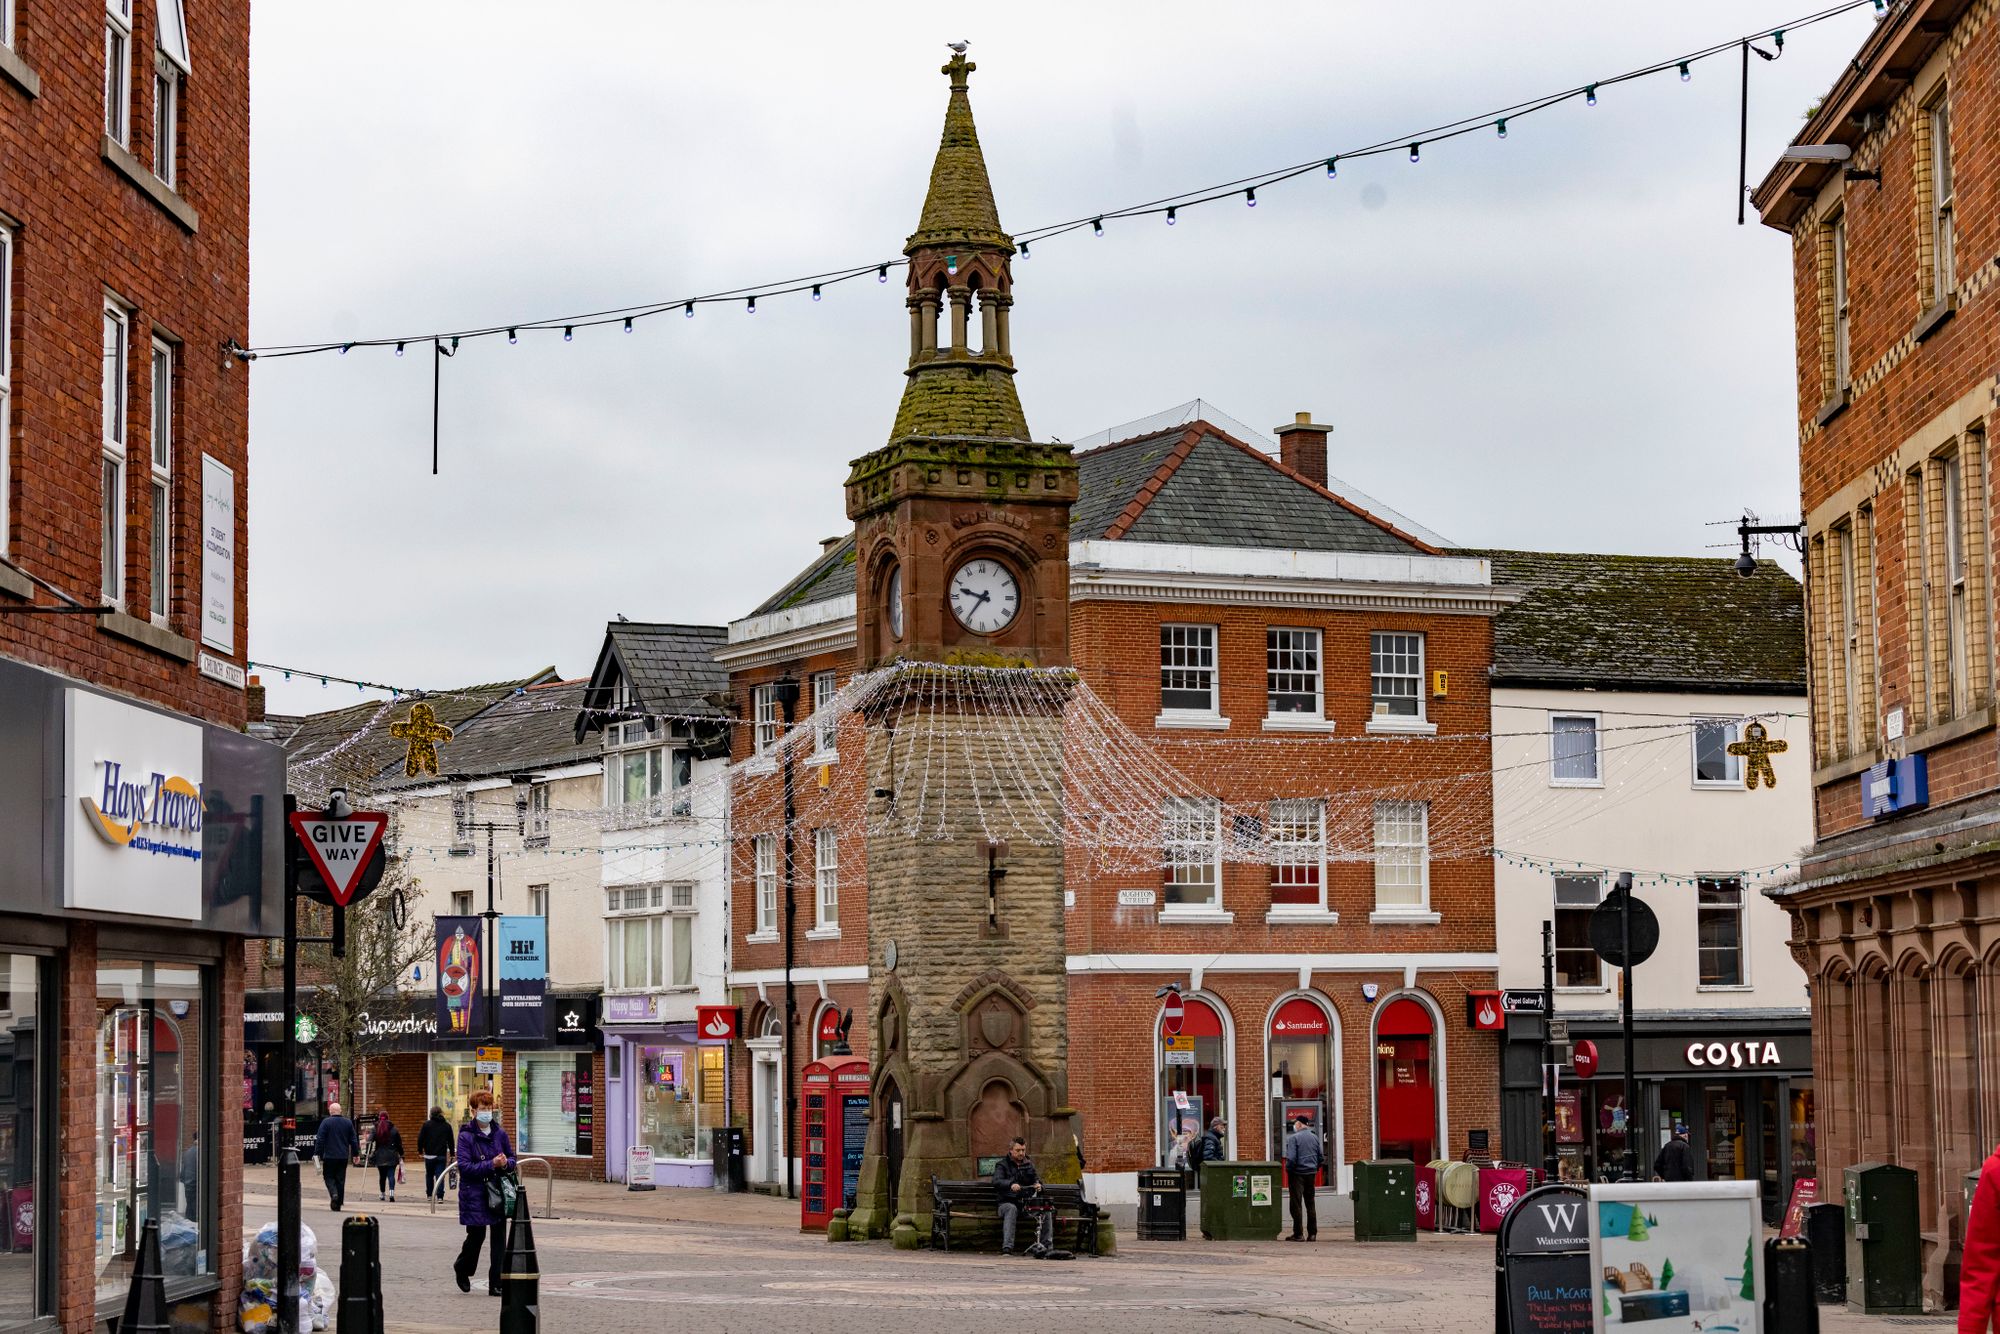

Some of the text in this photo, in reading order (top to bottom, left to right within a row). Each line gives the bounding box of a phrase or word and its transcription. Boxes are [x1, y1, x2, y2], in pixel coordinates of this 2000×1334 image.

[204, 657, 242, 684] CHURCH STREET
[100, 760, 203, 836] Hays Travel
[312, 824, 367, 843] GIVE
[325, 848, 359, 861] WAY
[510, 940, 535, 955] Hi!
[1507, 997, 1537, 1006] Chapel Gallery
[358, 1011, 438, 1041] Superdru
[1286, 1020, 1324, 1030] Santander
[1575, 1054, 1590, 1064] COSTA
[1686, 1041, 1781, 1069] COSTA
[1493, 1183, 1515, 1195] COSTA
[1537, 1203, 1582, 1233] W
[1536, 1236, 1591, 1247] Waterstones
[1527, 1285, 1553, 1301] PAUL
